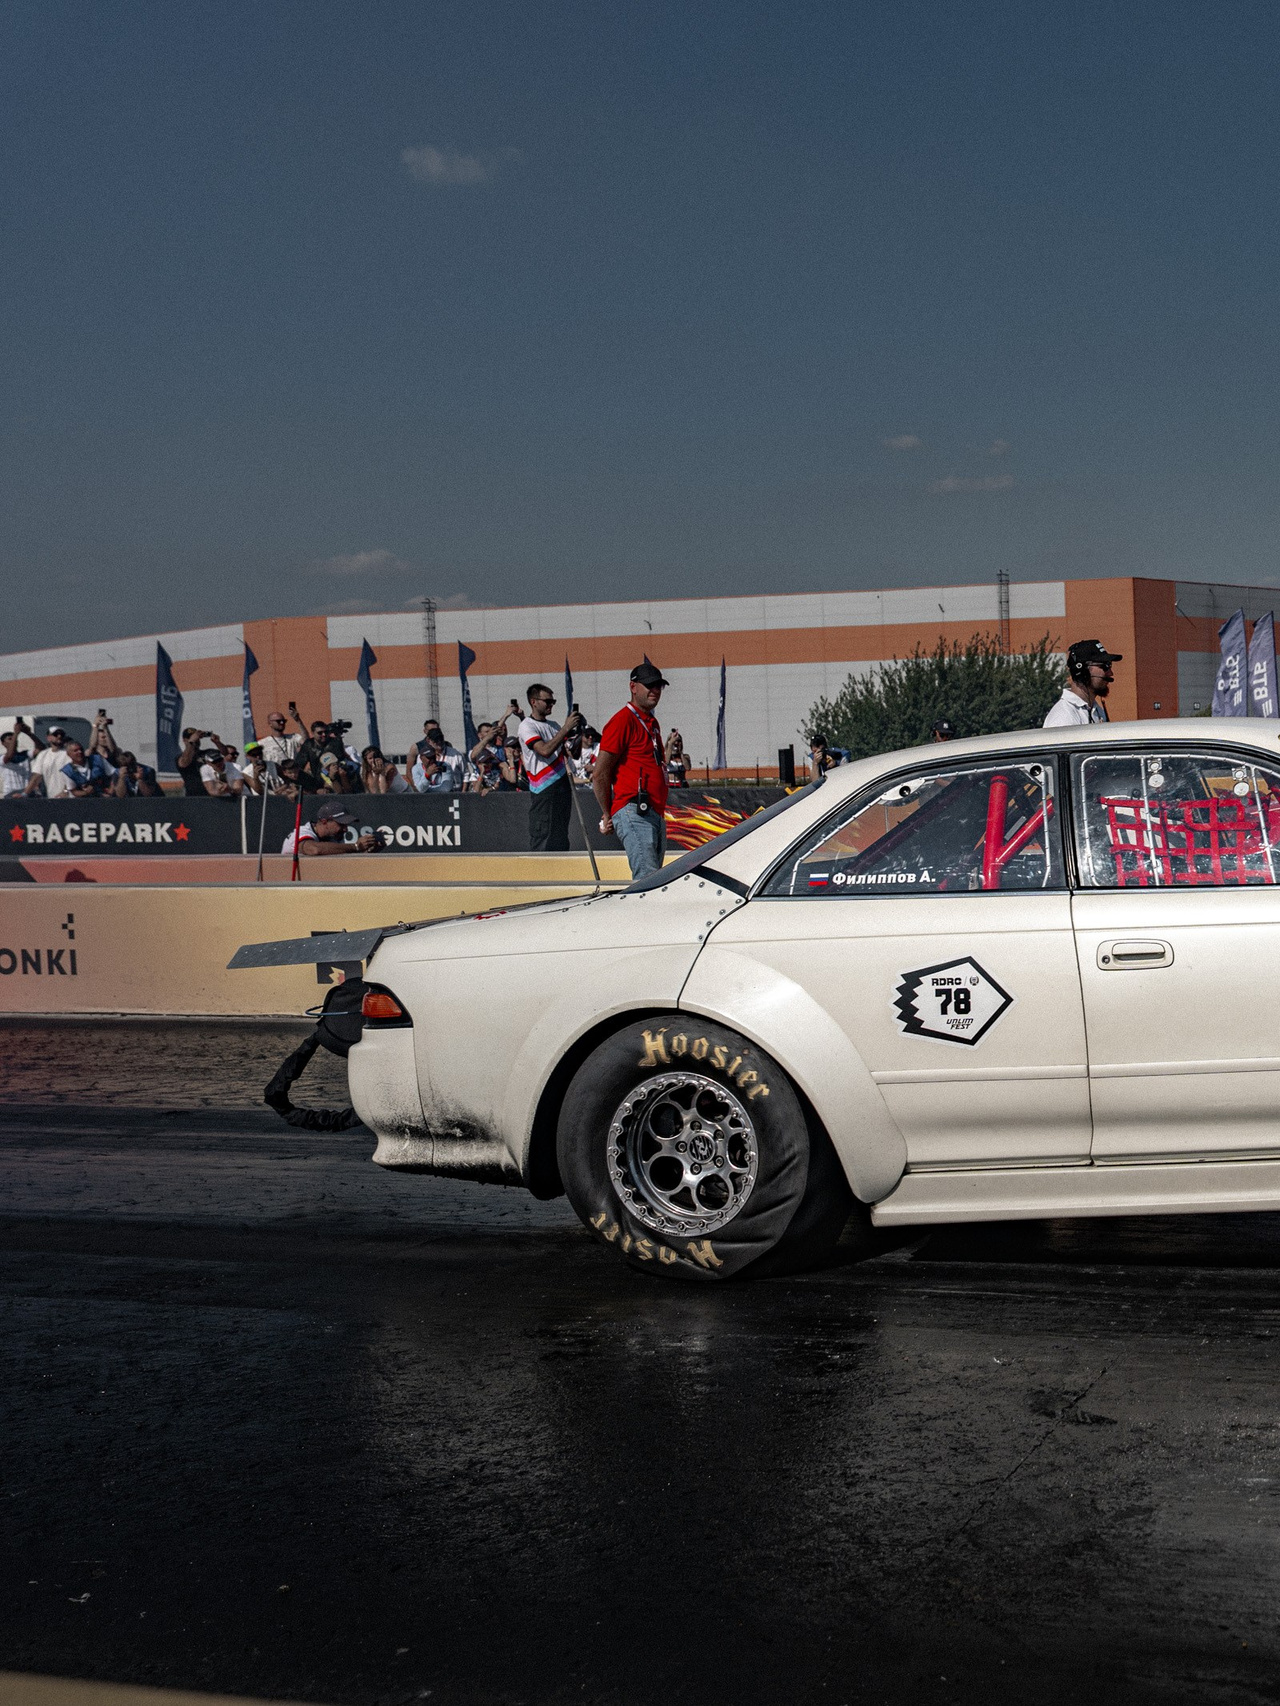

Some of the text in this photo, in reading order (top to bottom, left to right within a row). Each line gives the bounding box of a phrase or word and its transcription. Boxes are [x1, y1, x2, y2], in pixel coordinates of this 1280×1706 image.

[26, 822, 173, 843] RACEPARK
[832, 870, 936, 885] Филиппов А.
[0, 948, 78, 975] ONKI
[931, 977, 962, 986] RDRC
[935, 988, 971, 1015] 78
[638, 1027, 770, 1100] Hoosier
